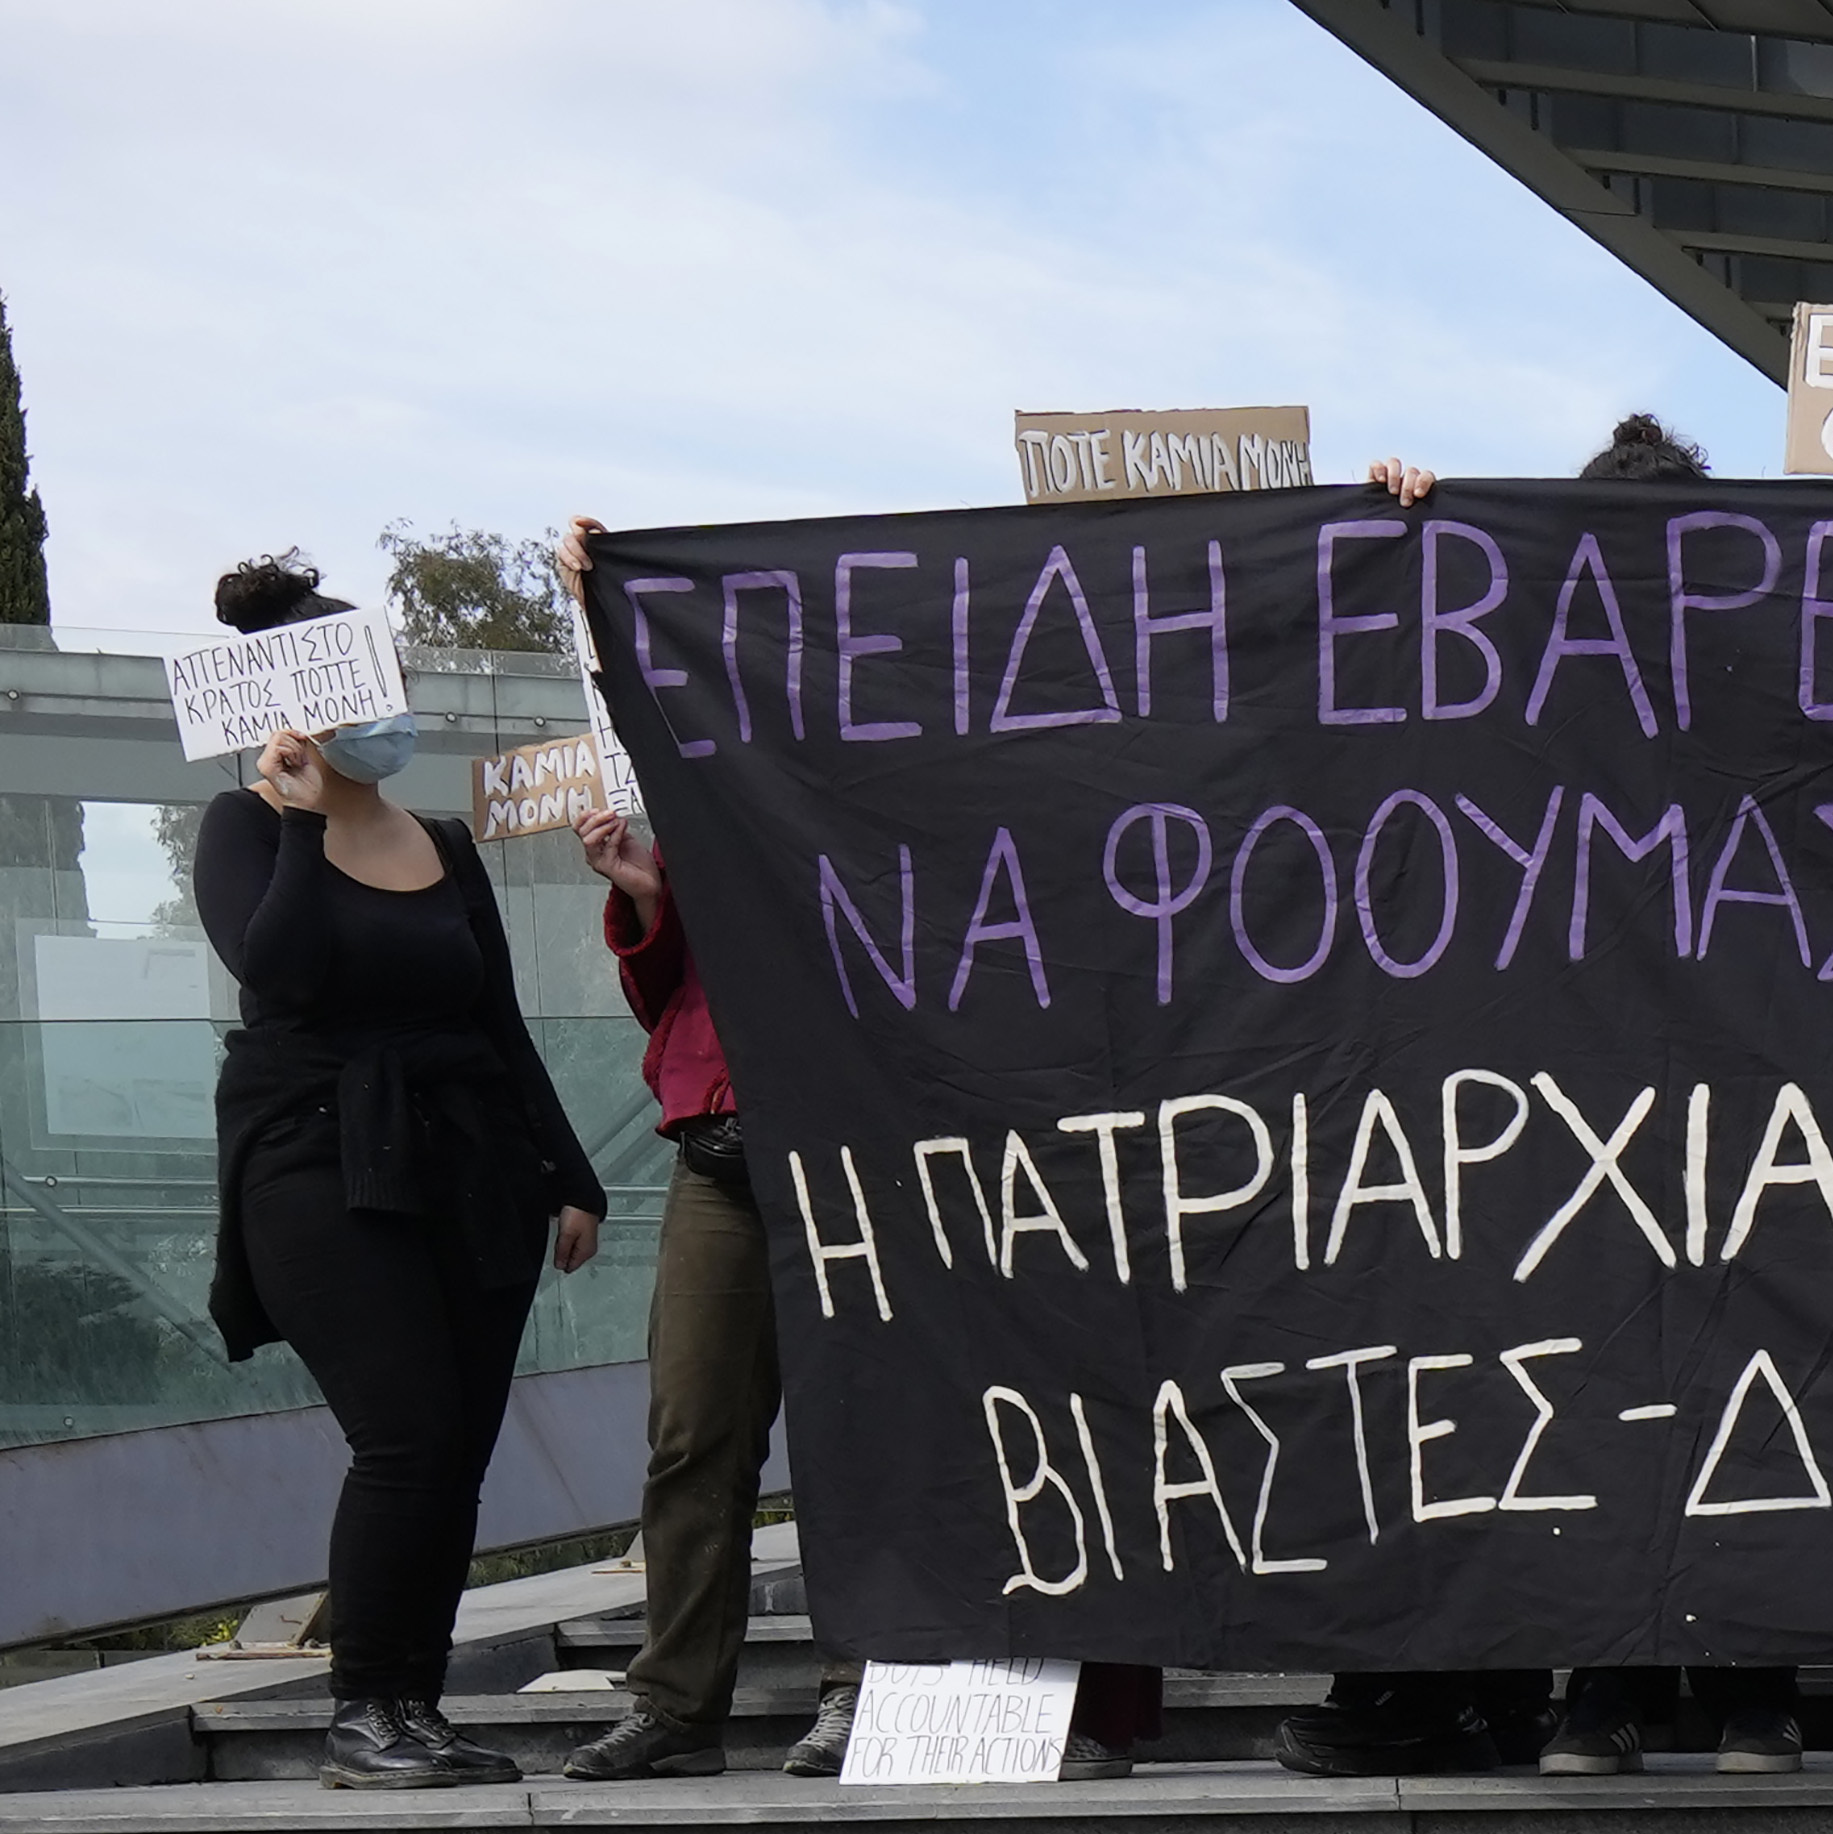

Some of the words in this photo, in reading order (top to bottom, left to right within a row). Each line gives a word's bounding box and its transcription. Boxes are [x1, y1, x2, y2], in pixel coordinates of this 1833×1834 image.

[1019, 429, 1116, 498] ΠΟΤΕ
[1121, 429, 1239, 492] ΚΑΜΙΑ
[624, 539, 1229, 760] ΕΠΕΙΔΗ
[818, 827, 1051, 1020] ΝΑ
[789, 1148, 893, 1322] Η
[848, 1737, 898, 1777] FOR
[907, 1735, 969, 1775] THEIR
[969, 1736, 1065, 1775] ACTIONS
[857, 1688, 1055, 1734] ACCOUNTABLE
